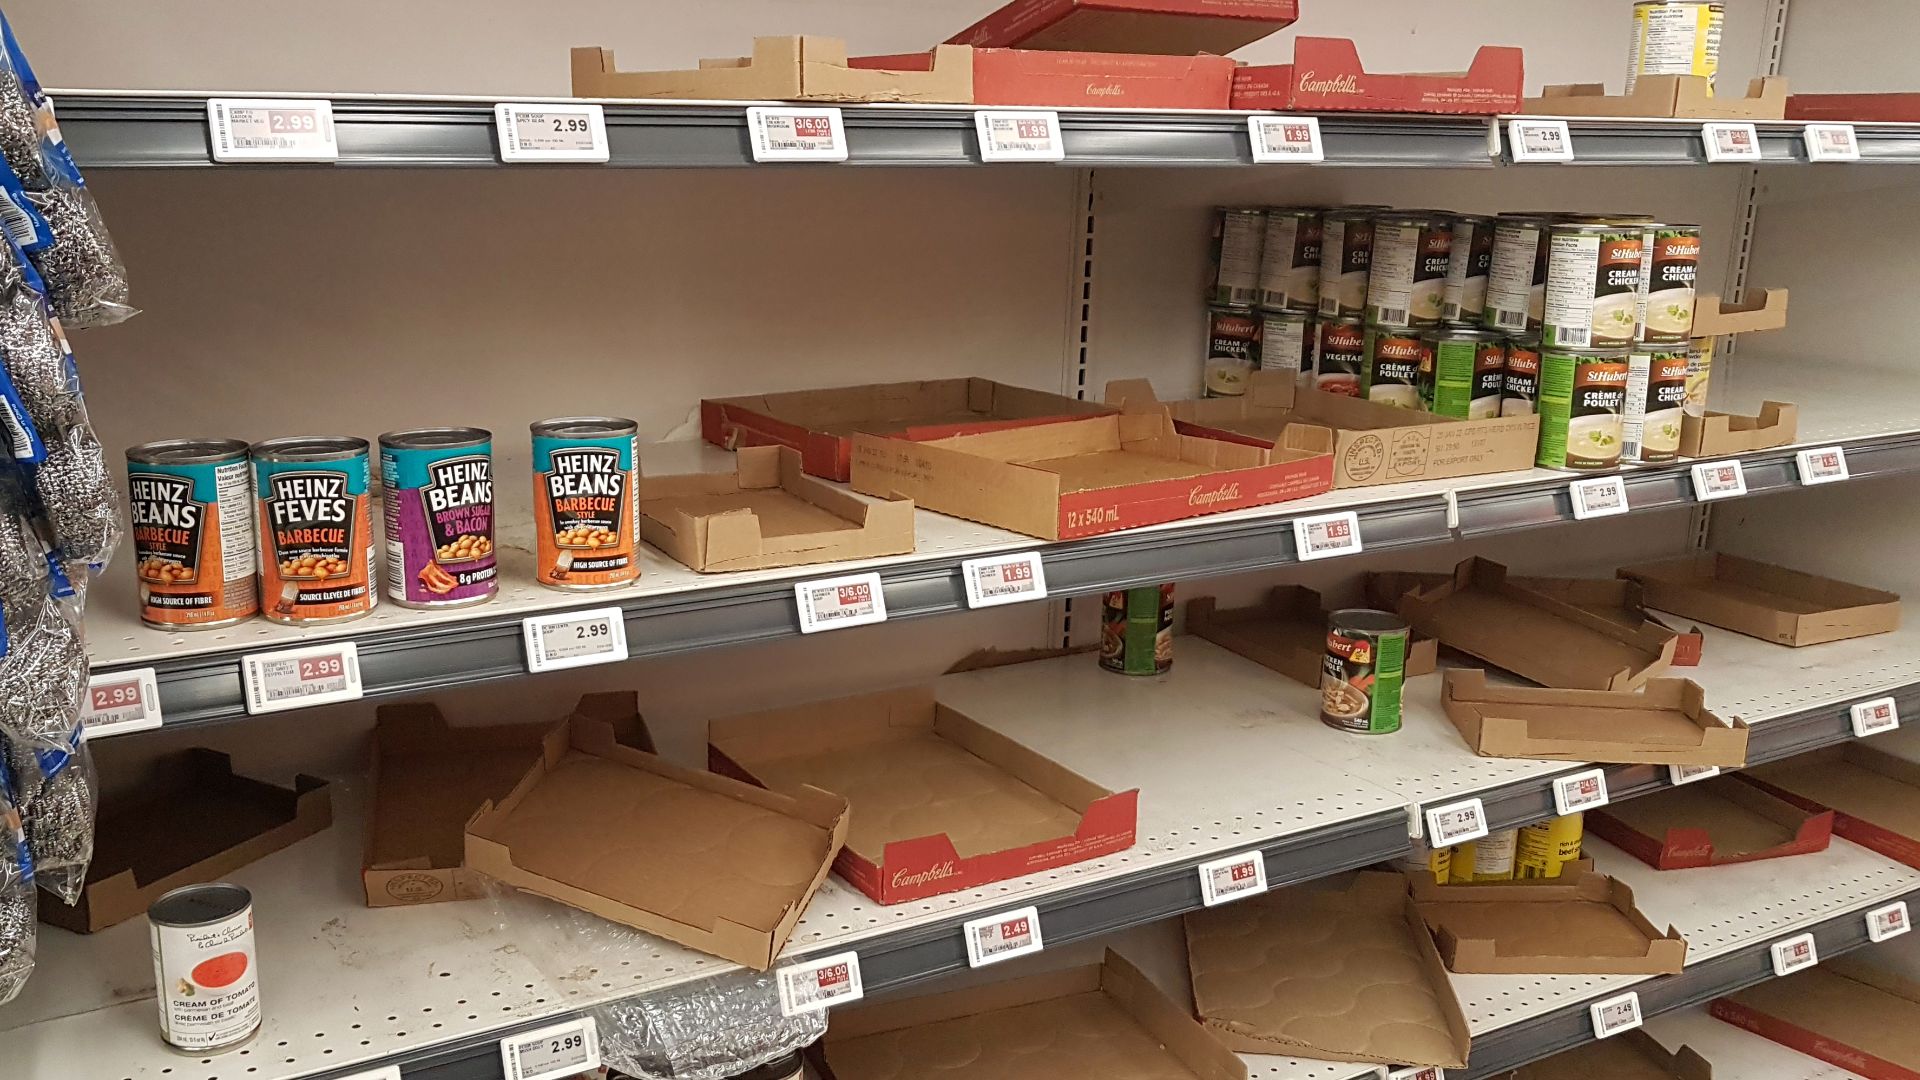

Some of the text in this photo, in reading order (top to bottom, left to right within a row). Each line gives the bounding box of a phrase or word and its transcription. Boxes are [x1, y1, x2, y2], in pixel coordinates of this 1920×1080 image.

[1086, 82, 1121, 98] Campbell's
[1300, 70, 1356, 97] Campbell's
[273, 114, 314, 130] 2.99
[552, 119, 588, 132] 2.99
[796, 118, 829, 129] 3/6.00
[1020, 126, 1047, 137] 1.99
[1286, 130, 1309, 141] 1.99
[1541, 131, 1560, 141] 2.99
[1380, 363, 1411, 372] CRÈME
[1380, 370, 1414, 378] POULET
[1584, 391, 1616, 400] CRÈME
[557, 455, 614, 474] HEINZ
[438, 462, 488, 486] HEINZ
[132, 480, 184, 503] HEINZ
[277, 480, 340, 500] HEINZ
[550, 474, 621, 497] BEANS
[1600, 487, 1617, 496] 2.99
[429, 481, 492, 512] BEANS
[1188, 483, 1242, 508] Campbell's
[556, 497, 615, 512] BARBECUE
[131, 502, 197, 528] BEANS
[436, 506, 470, 524] BROWN
[1067, 505, 1119, 528] 12 x 540 mL
[445, 517, 488, 536] & BACON
[1329, 525, 1348, 537] 1.99
[135, 526, 190, 545] BARBECUE
[277, 528, 345, 546] BARBECUE
[150, 542, 167, 550] STYLE
[1004, 568, 1030, 580] 1.99
[839, 584, 869, 598] 3/6.00
[162, 596, 184, 606] SOURCE
[194, 596, 212, 604] FIBRE
[576, 624, 608, 639] 2.99
[302, 659, 341, 678] 2.99
[96, 686, 137, 706] 2.99
[1457, 811, 1475, 822] 2.99
[891, 860, 954, 888] Campbell's
[1234, 866, 1254, 879] 1.99
[1004, 922, 1028, 936] 2.49
[818, 964, 847, 980] 3/6.00
[210, 998, 223, 1006] OF
[226, 981, 256, 1002] TOMATO
[174, 1013, 207, 1021] CRÈME
[227, 996, 256, 1015] TOMATE
[551, 1035, 582, 1053] 2.99
